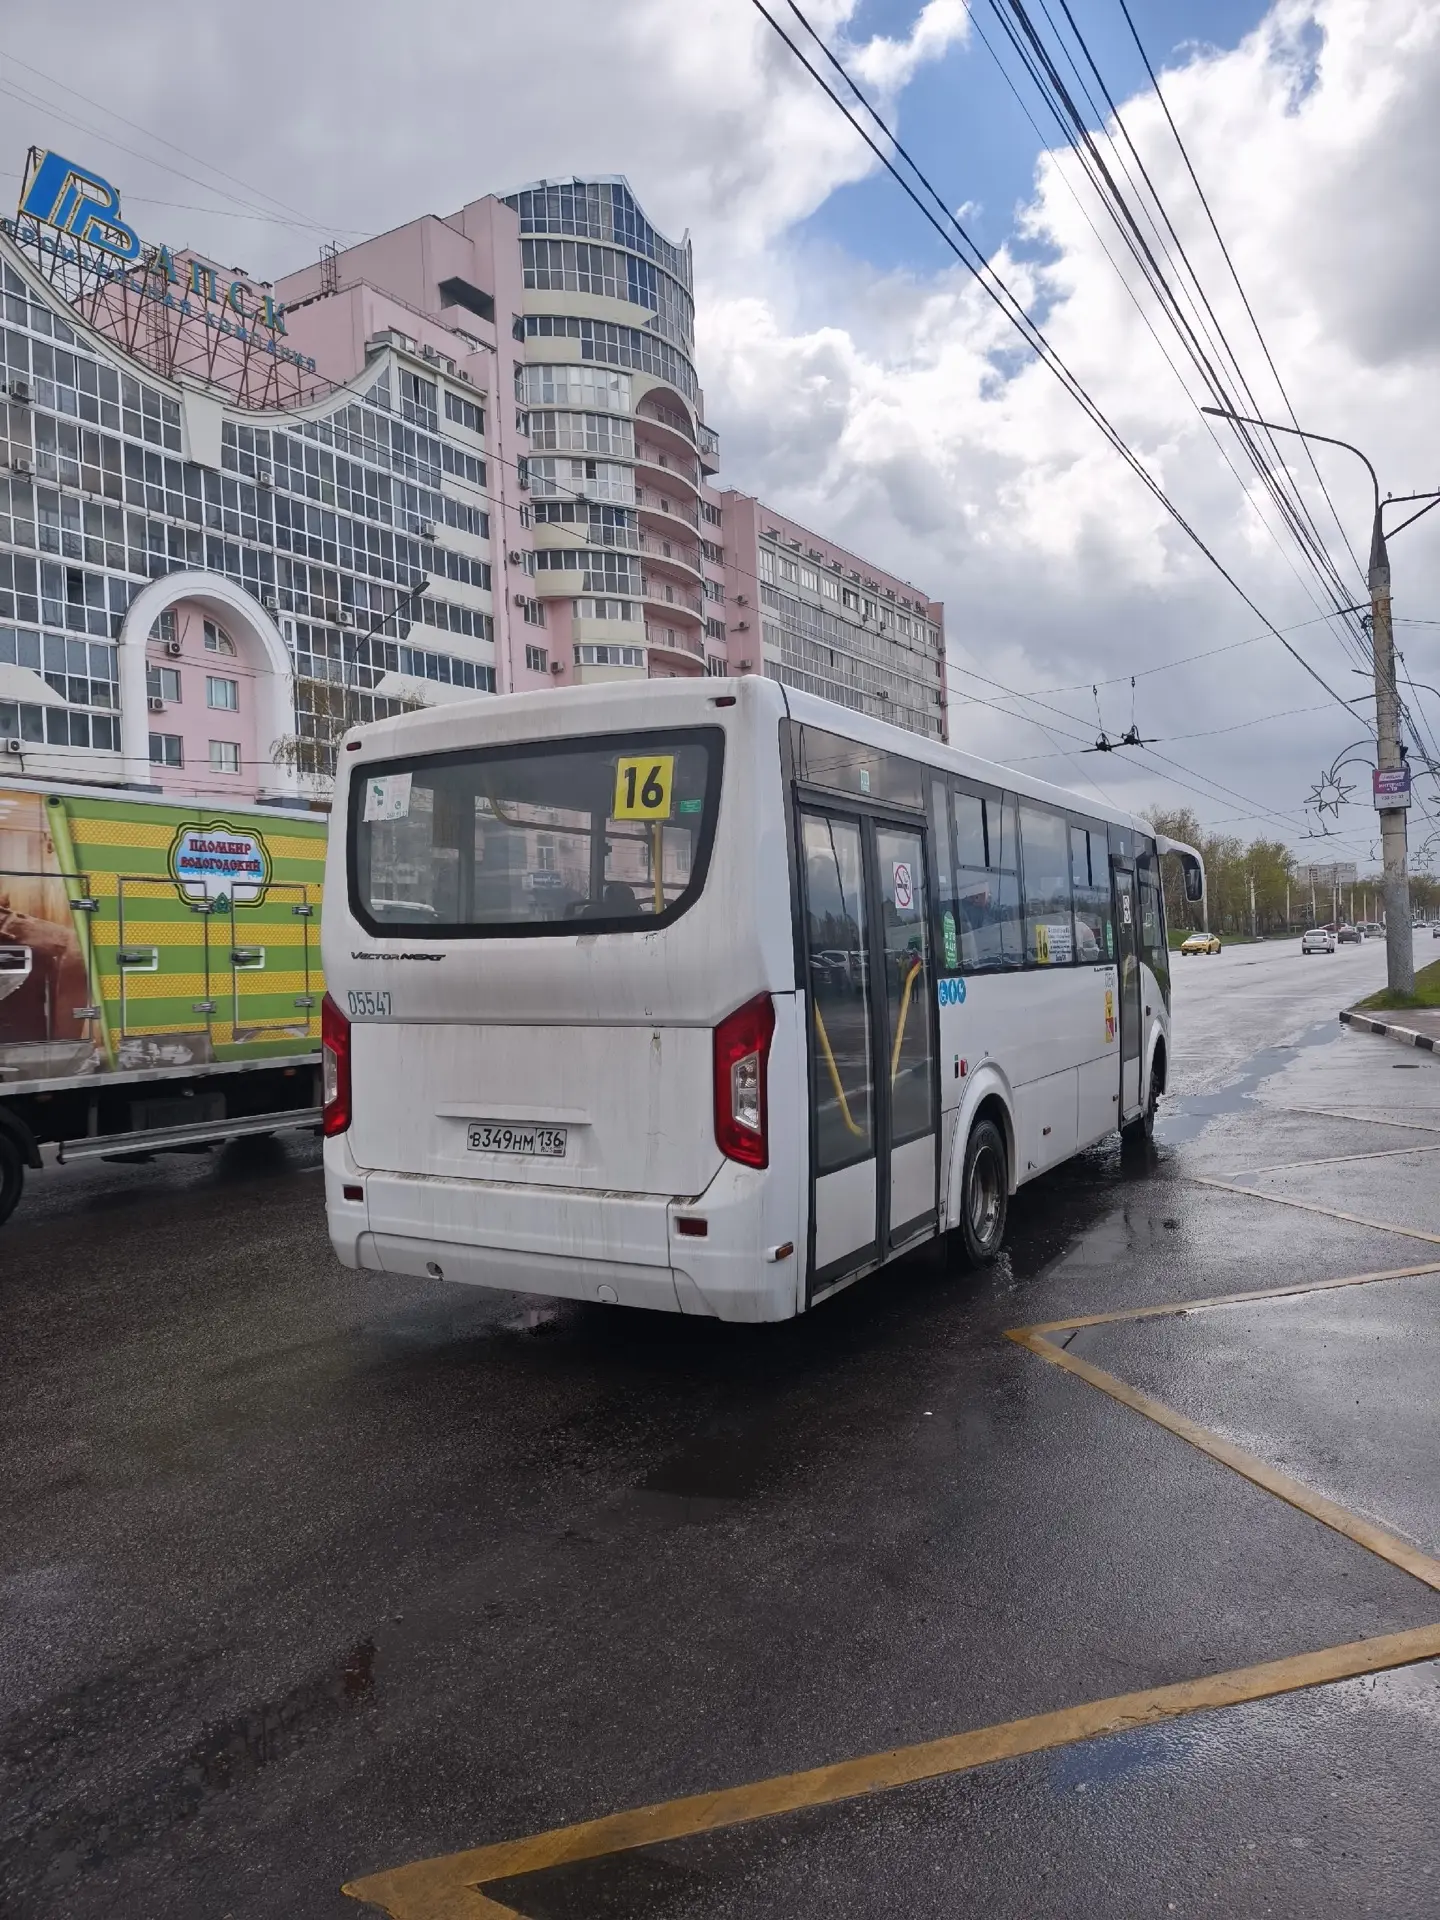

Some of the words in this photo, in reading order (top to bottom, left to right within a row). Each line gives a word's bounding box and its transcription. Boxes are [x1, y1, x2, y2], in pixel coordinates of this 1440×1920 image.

[205, 310, 317, 373] КОМПАНИЯ
[623, 765, 665, 809] 16
[188, 838, 252, 855] ПЛОМБИР
[180, 856, 261, 872] ВОЛОГОДСКИЙ
[347, 990, 392, 1016] 05547
